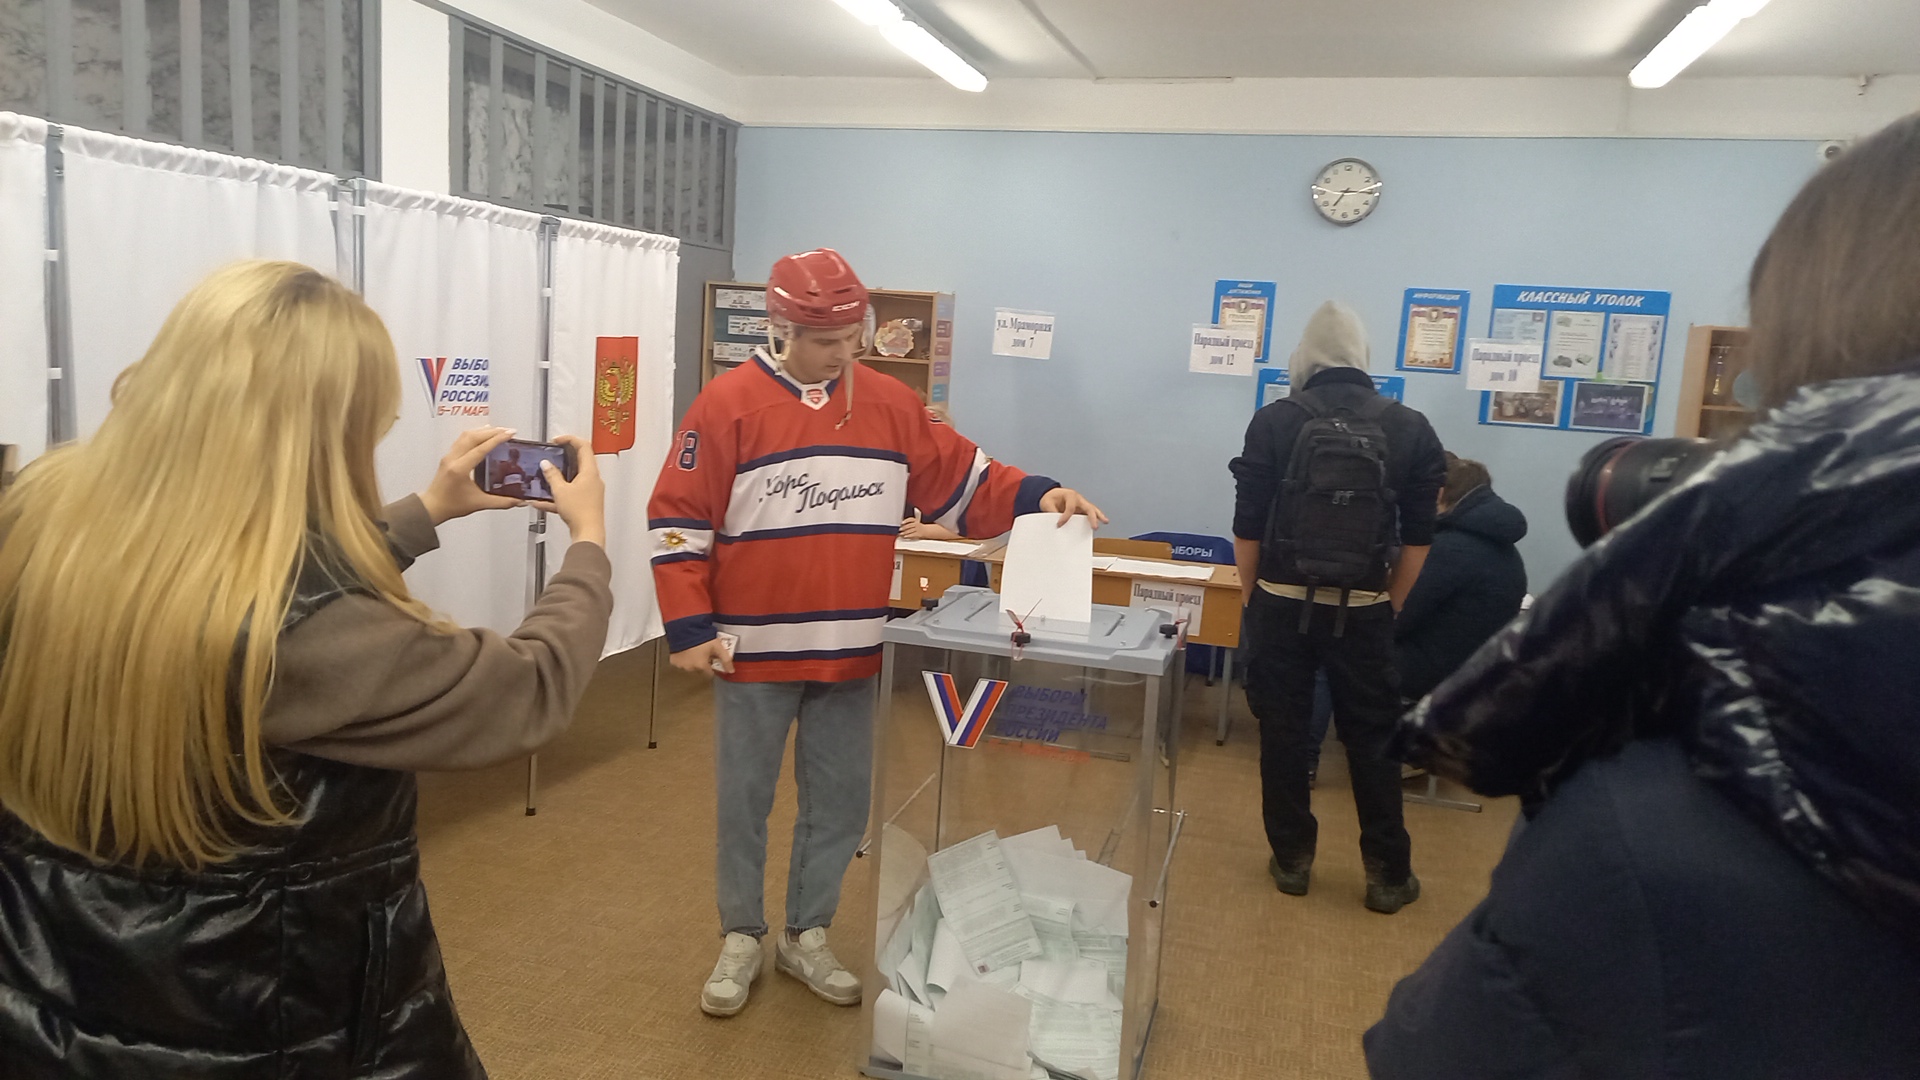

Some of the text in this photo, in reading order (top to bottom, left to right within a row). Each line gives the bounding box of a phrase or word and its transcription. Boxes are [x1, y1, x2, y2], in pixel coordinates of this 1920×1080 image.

[1516, 290, 1645, 308] КЛАССНЫЙ УГОЛОК
[1194, 332, 1230, 349] Парадный
[1226, 353, 1235, 366] 12
[1171, 545, 1213, 558] ЫБОРЫ
[1133, 583, 1174, 601] Парадный
